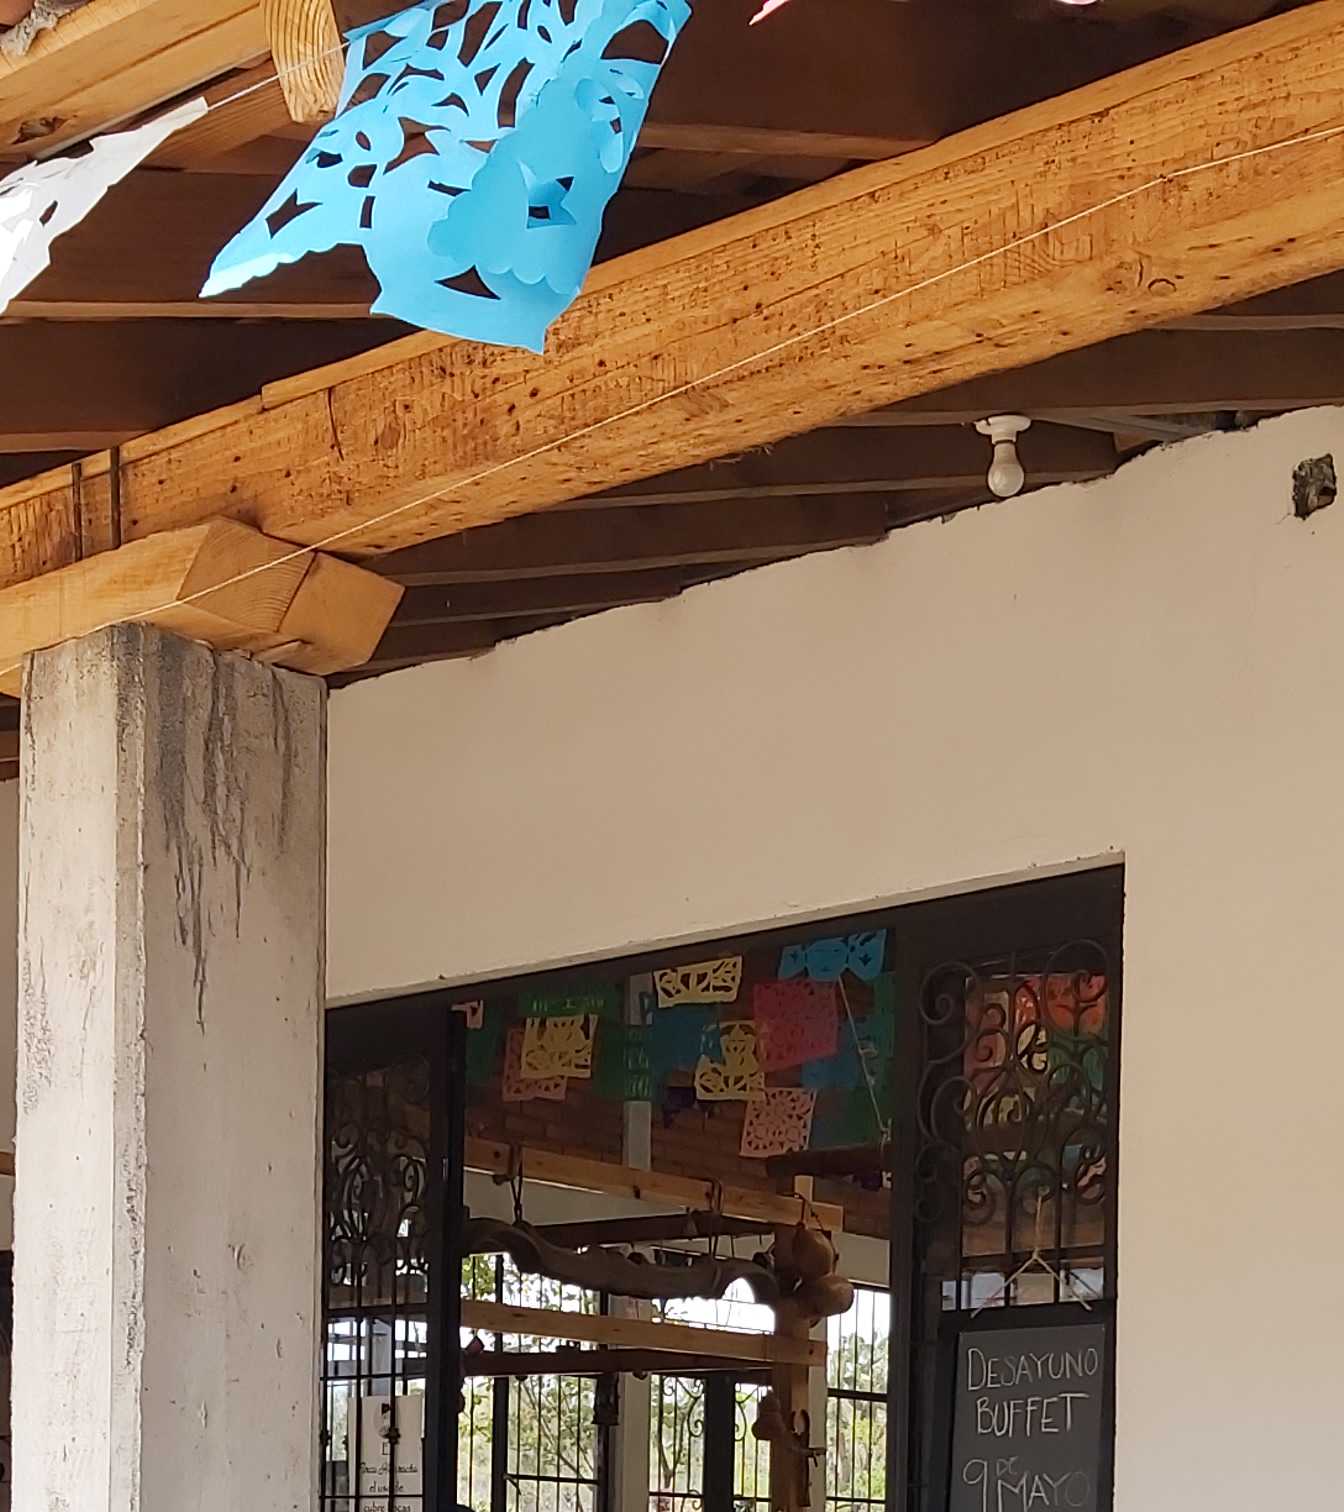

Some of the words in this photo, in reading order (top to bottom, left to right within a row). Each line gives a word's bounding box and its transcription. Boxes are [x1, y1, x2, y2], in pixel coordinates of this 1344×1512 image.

[966, 1347, 1099, 1392] DESAYUNO
[975, 1391, 1090, 1438] BUFFET
[363, 1500, 385, 1512] cubre
